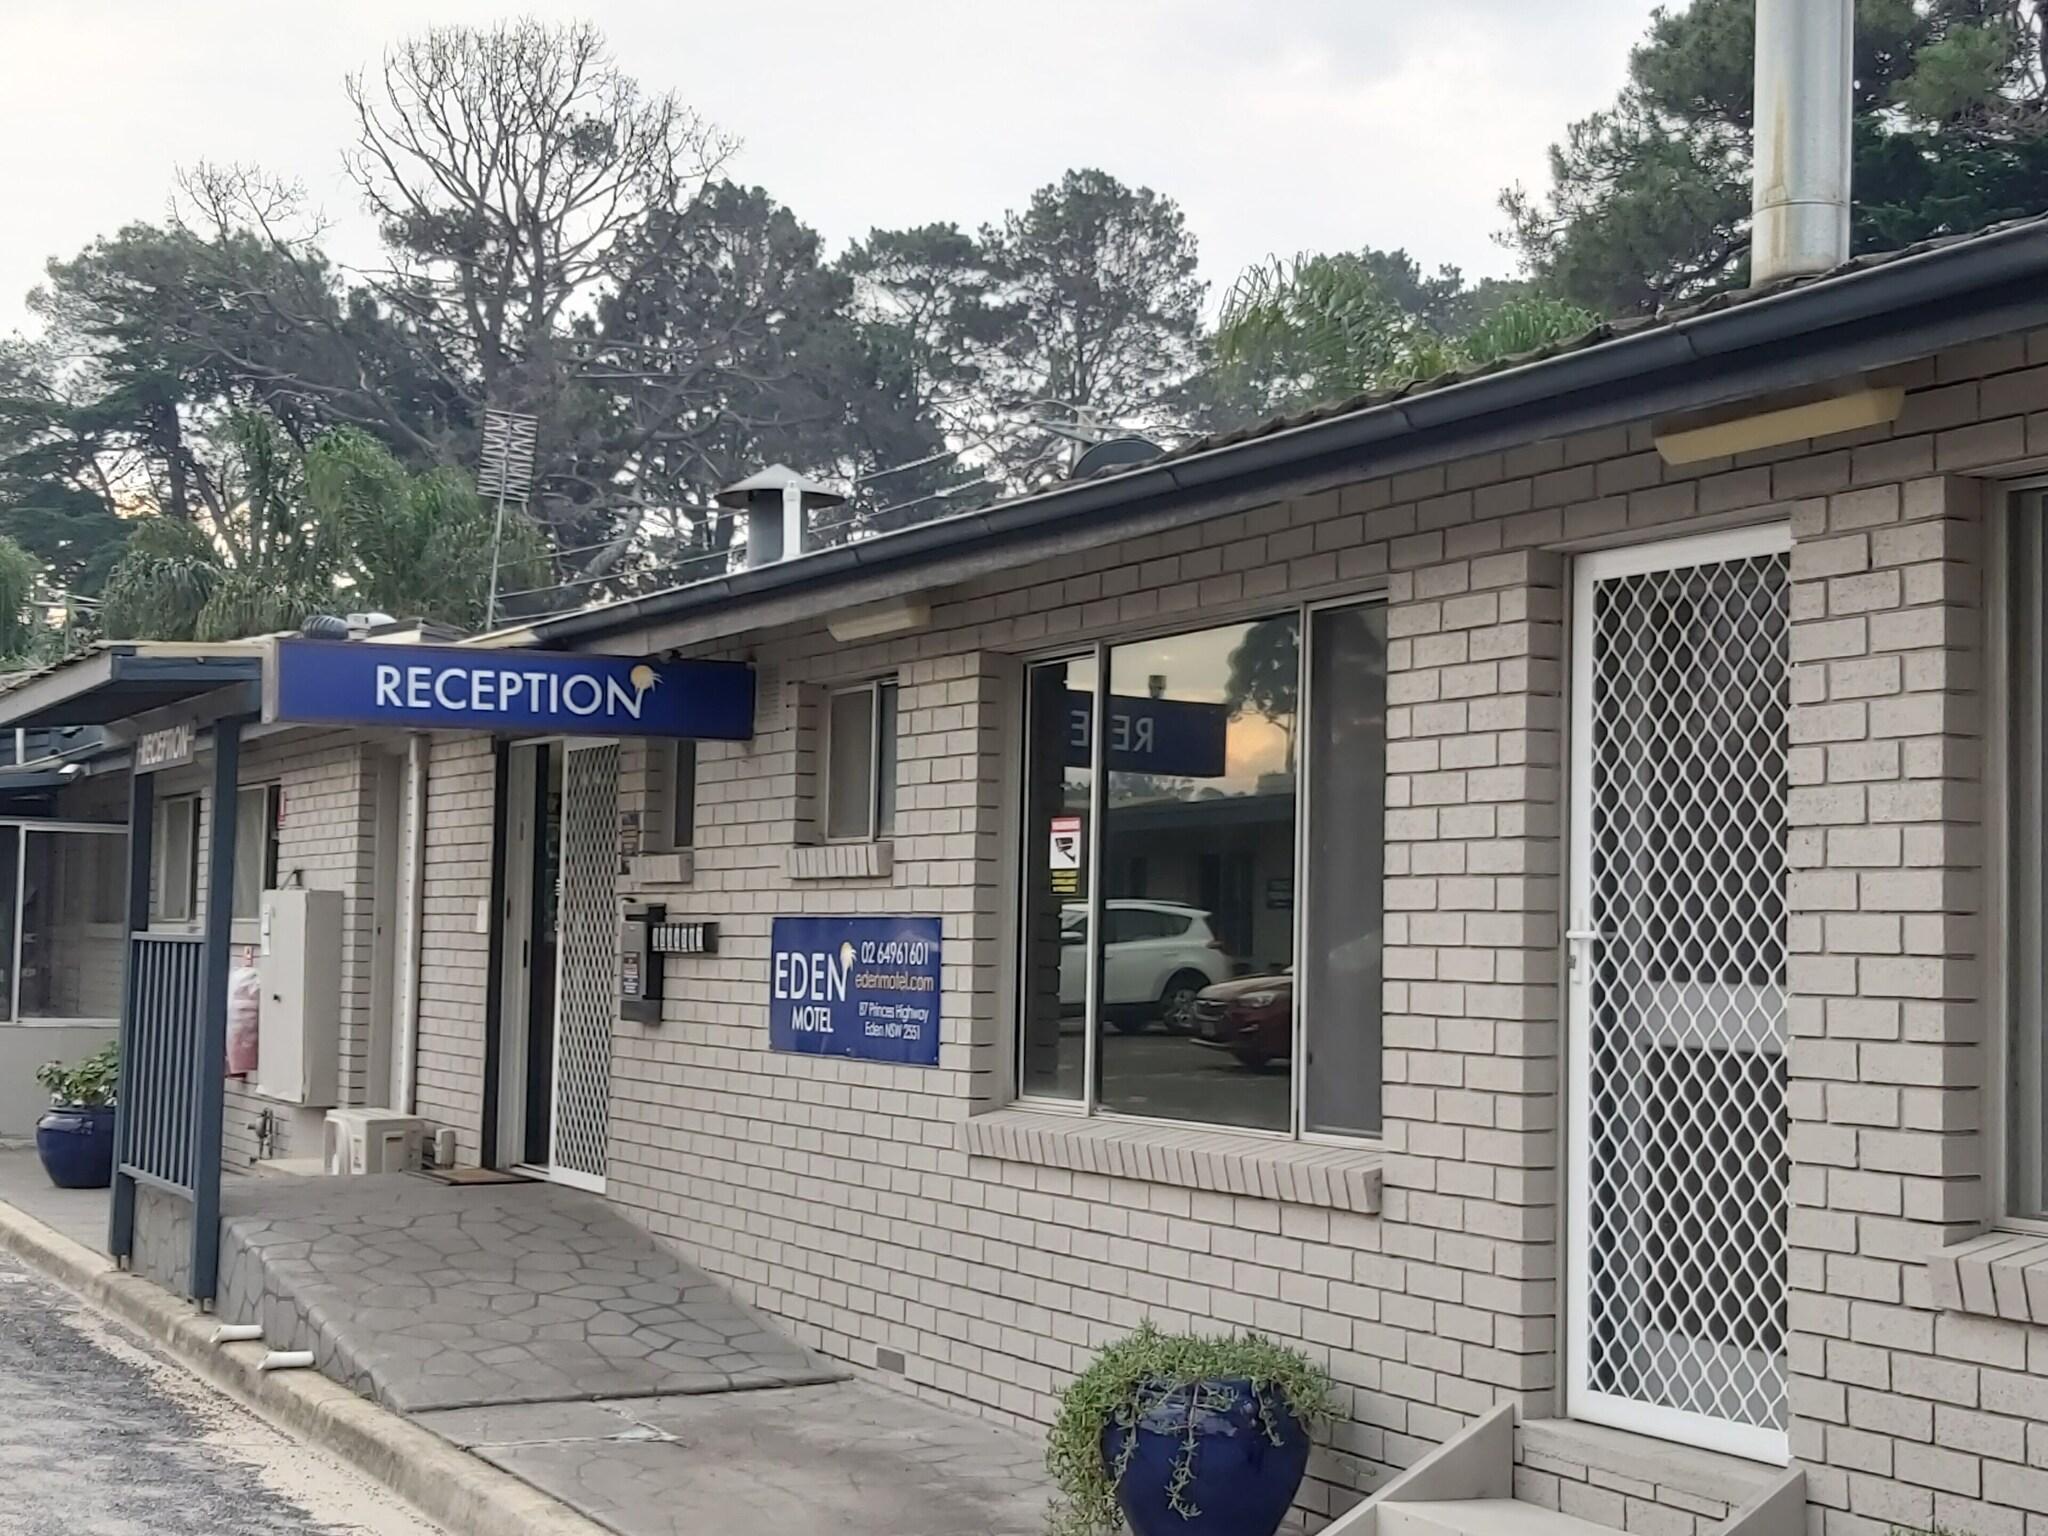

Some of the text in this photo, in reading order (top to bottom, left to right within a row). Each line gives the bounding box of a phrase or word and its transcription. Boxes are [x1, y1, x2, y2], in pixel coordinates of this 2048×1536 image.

[375, 664, 650, 719] RECEPTION
[861, 940, 876, 964] 02
[775, 949, 850, 1002] EDEN
[855, 970, 934, 992] edenmotel.com
[791, 1005, 834, 1033] MOTEL
[868, 1001, 895, 1019] Princes
[895, 1004, 930, 1024] Highway
[864, 1021, 884, 1036] Eden
[885, 1023, 903, 1038] NSW
